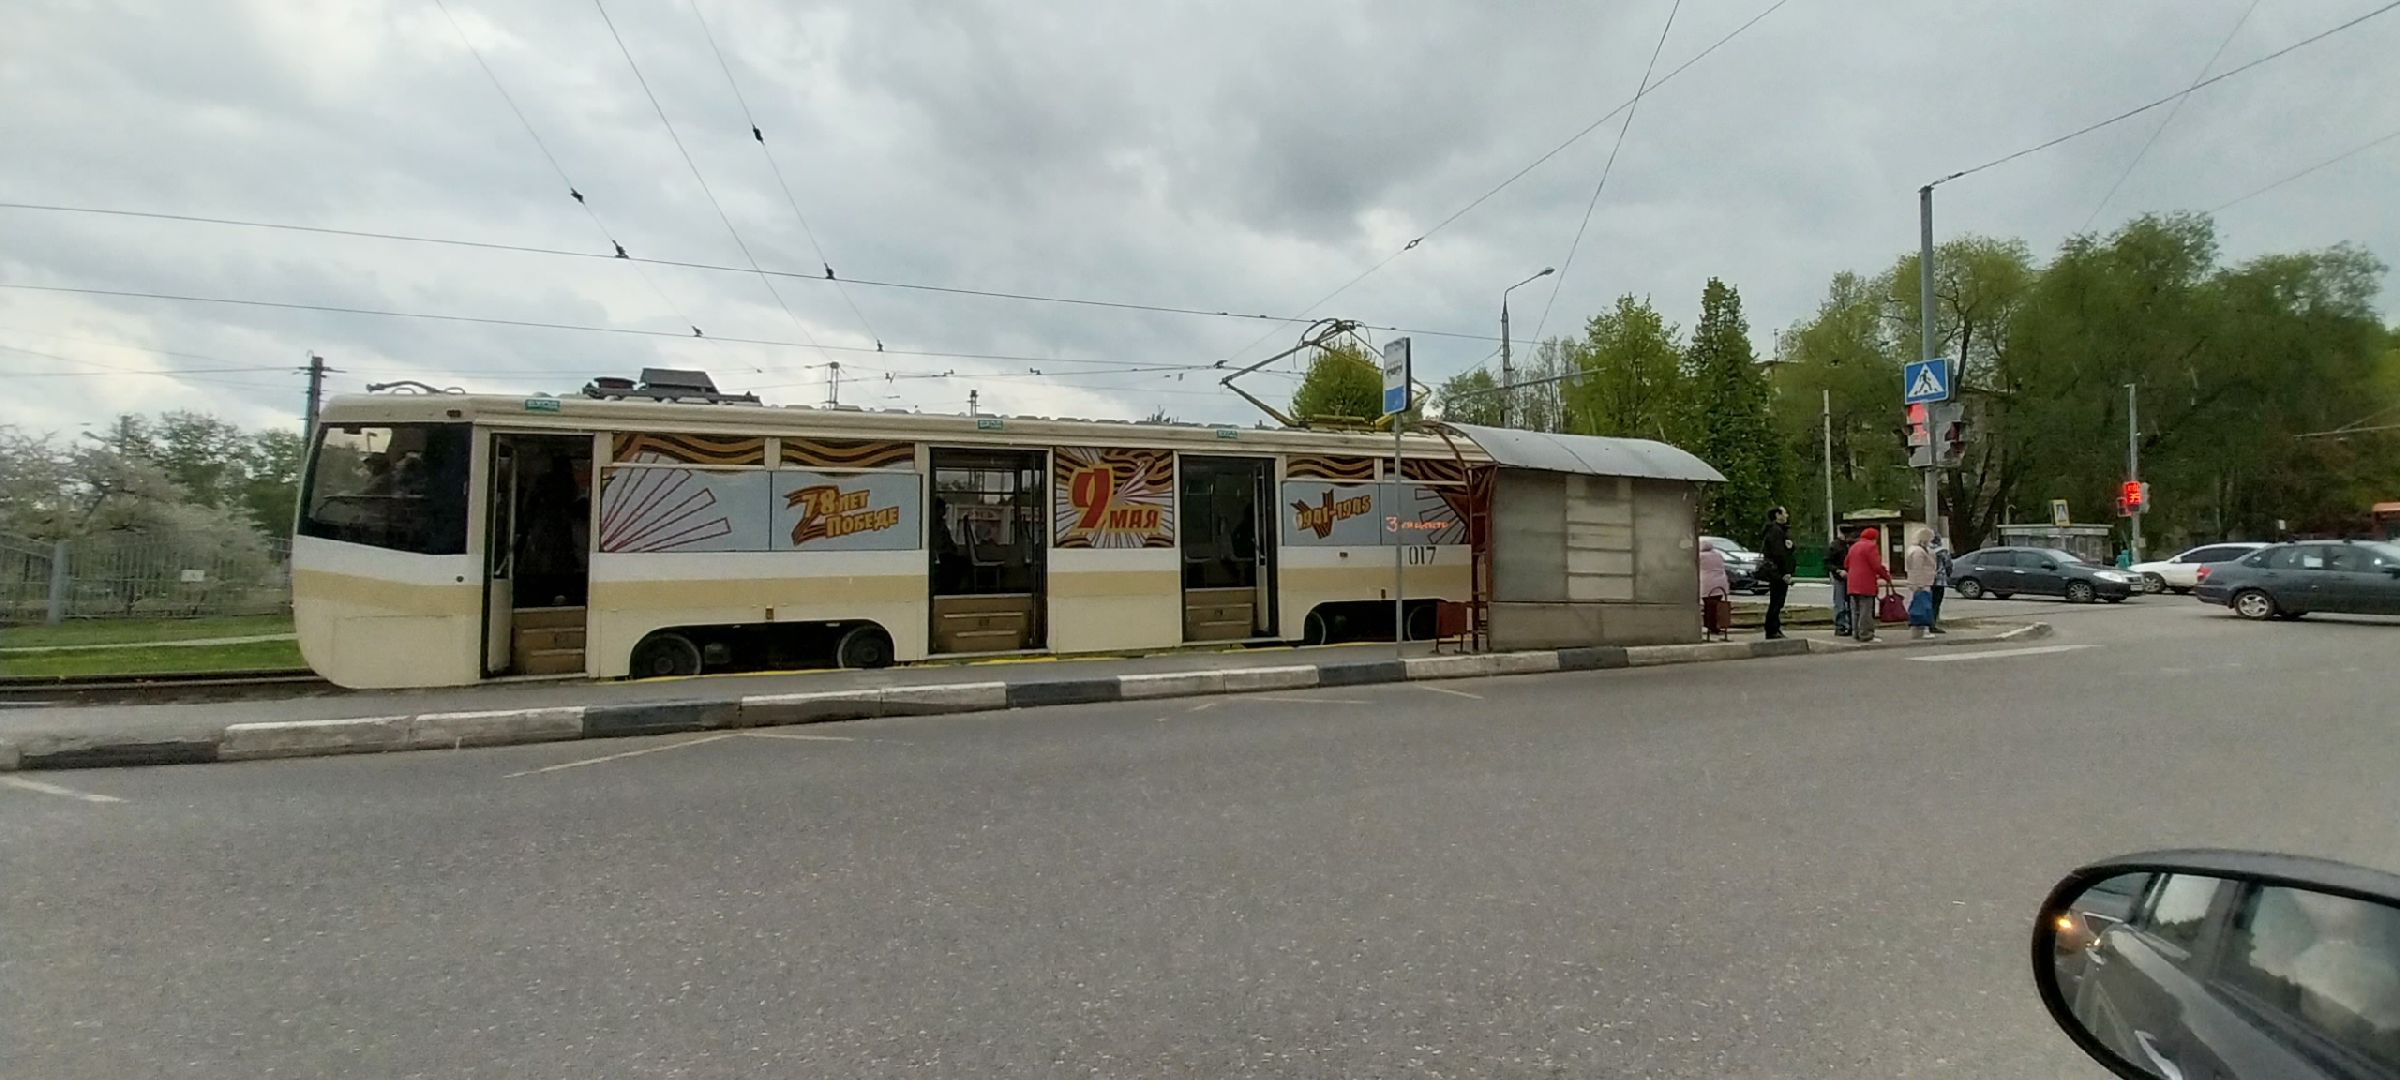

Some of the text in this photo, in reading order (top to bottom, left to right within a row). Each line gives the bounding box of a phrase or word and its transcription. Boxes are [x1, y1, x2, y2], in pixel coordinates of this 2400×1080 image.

[802, 488, 870, 519] 78 ЛЕТ
[1072, 468, 1158, 528] 9 МАЯ
[826, 507, 899, 538] ПОБЕДЕ
[1386, 516, 1397, 532] 3
[1409, 546, 1436, 565] 017
